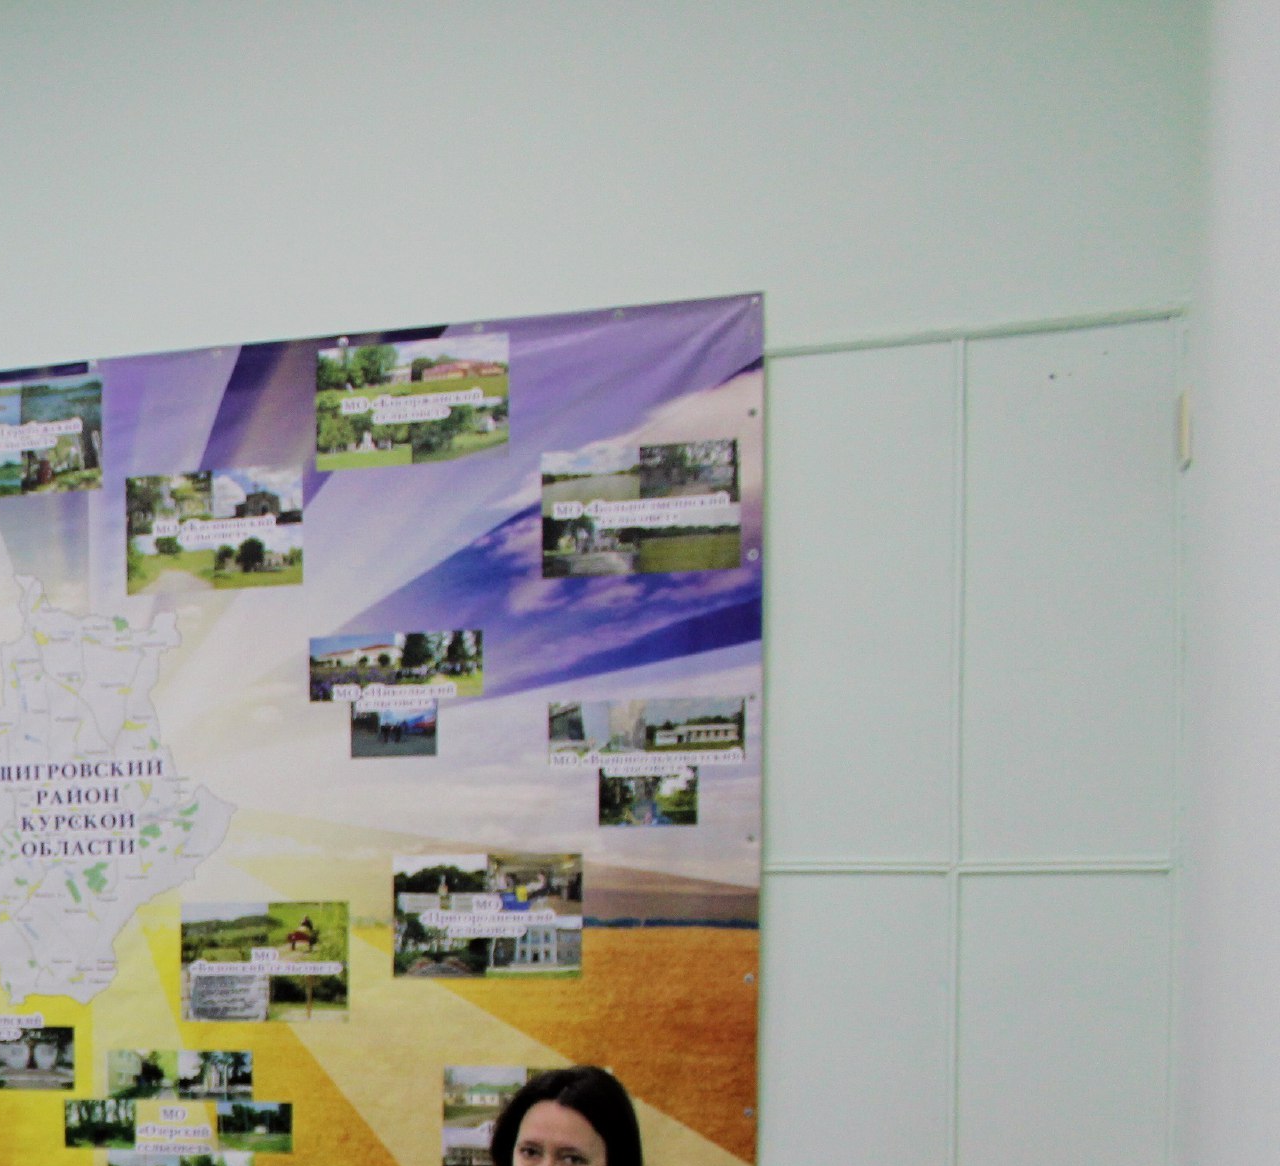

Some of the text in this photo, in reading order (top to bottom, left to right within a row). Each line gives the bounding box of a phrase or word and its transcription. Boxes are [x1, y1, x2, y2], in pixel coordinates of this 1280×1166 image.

[36, 786, 120, 806] РАЙОН
[21, 811, 136, 832] КУРСКОЙ
[20, 838, 136, 857] ОБЛАСТИ
[162, 1108, 187, 1120] МО
